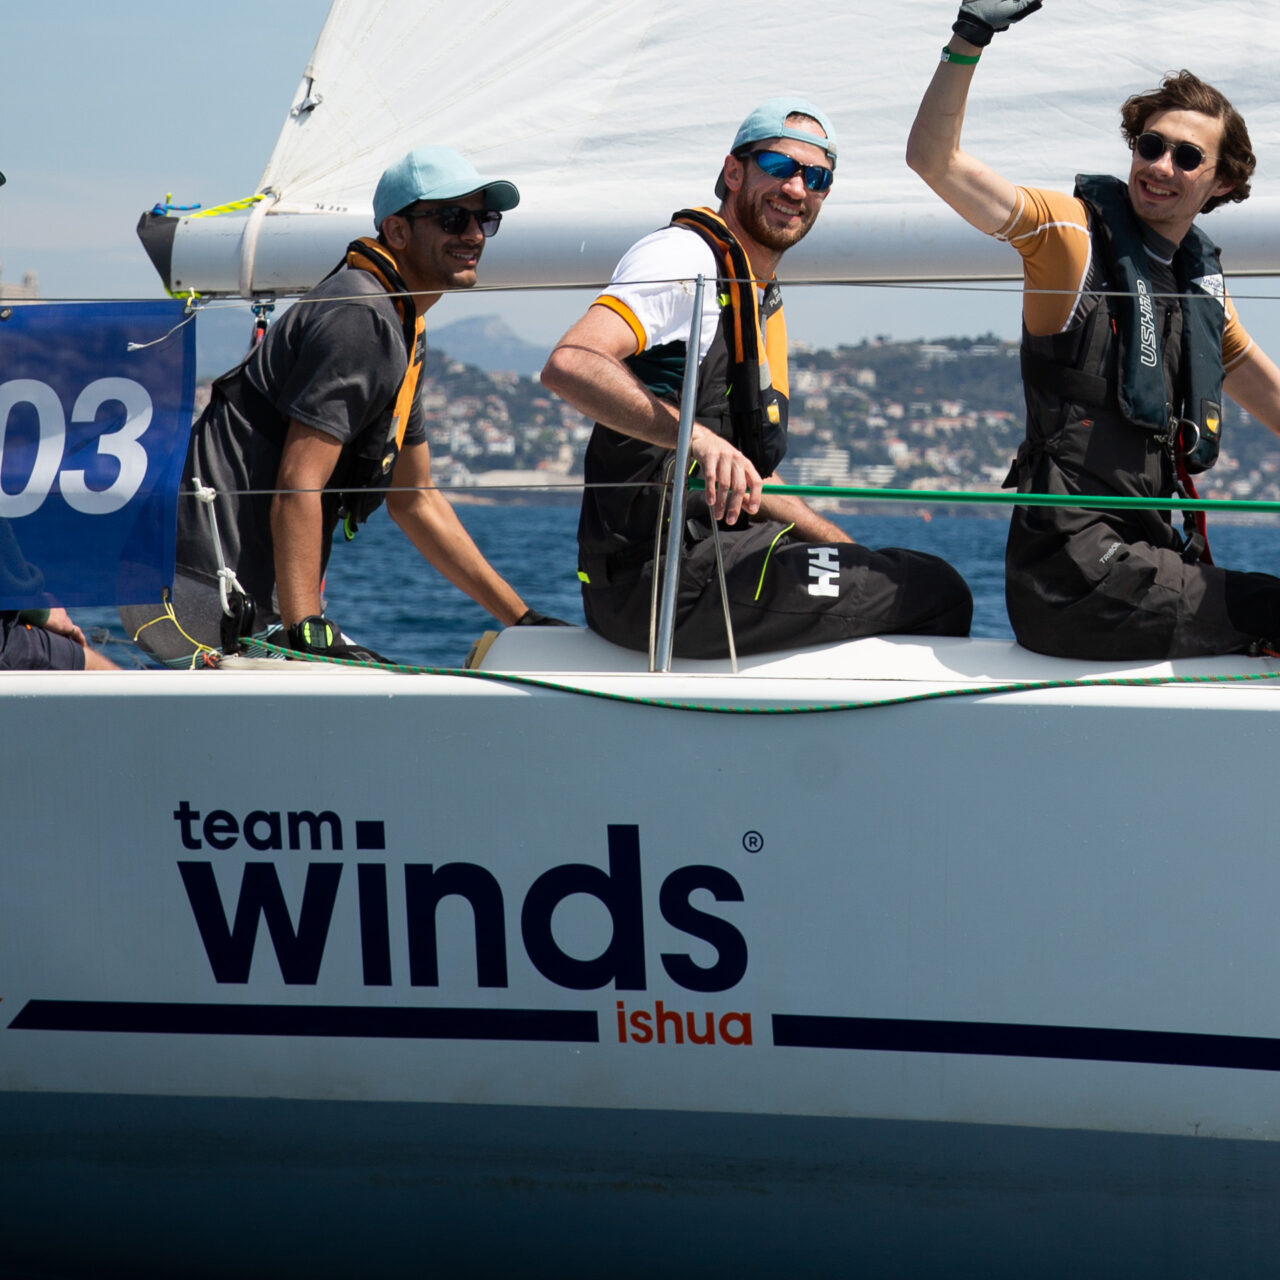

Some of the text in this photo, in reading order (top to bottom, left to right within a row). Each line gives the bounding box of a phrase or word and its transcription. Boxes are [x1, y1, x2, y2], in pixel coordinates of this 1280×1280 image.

[0, 376, 154, 519] 03
[173, 800, 343, 851] team
[176, 820, 749, 994] winds
[615, 999, 753, 1046] ishua
